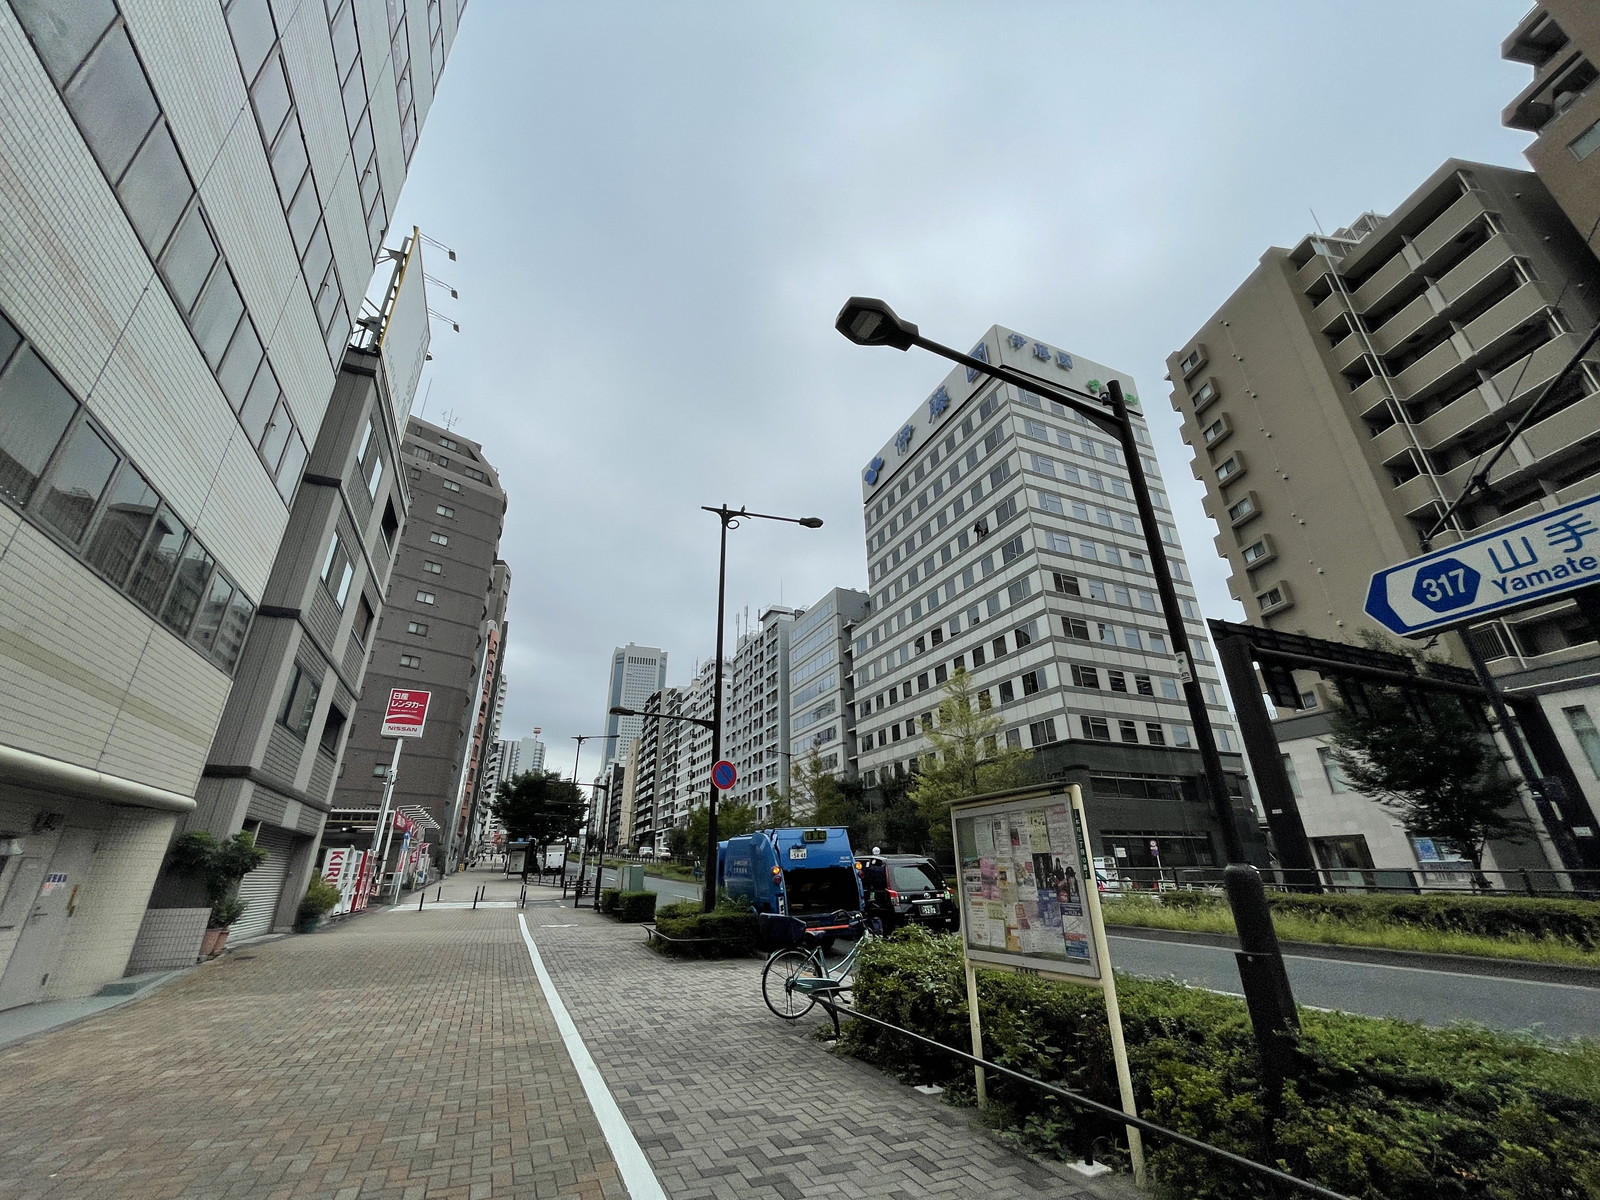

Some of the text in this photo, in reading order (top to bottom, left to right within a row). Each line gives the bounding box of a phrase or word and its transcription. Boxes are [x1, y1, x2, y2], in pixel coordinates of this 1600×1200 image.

[1488, 512, 1599, 574] 山手
[1422, 568, 1466, 603] 317
[1491, 556, 1598, 595] Yamate
[391, 700, 425, 709] レンタカー
[392, 692, 409, 701] 日産
[387, 725, 418, 733] NISSAN
